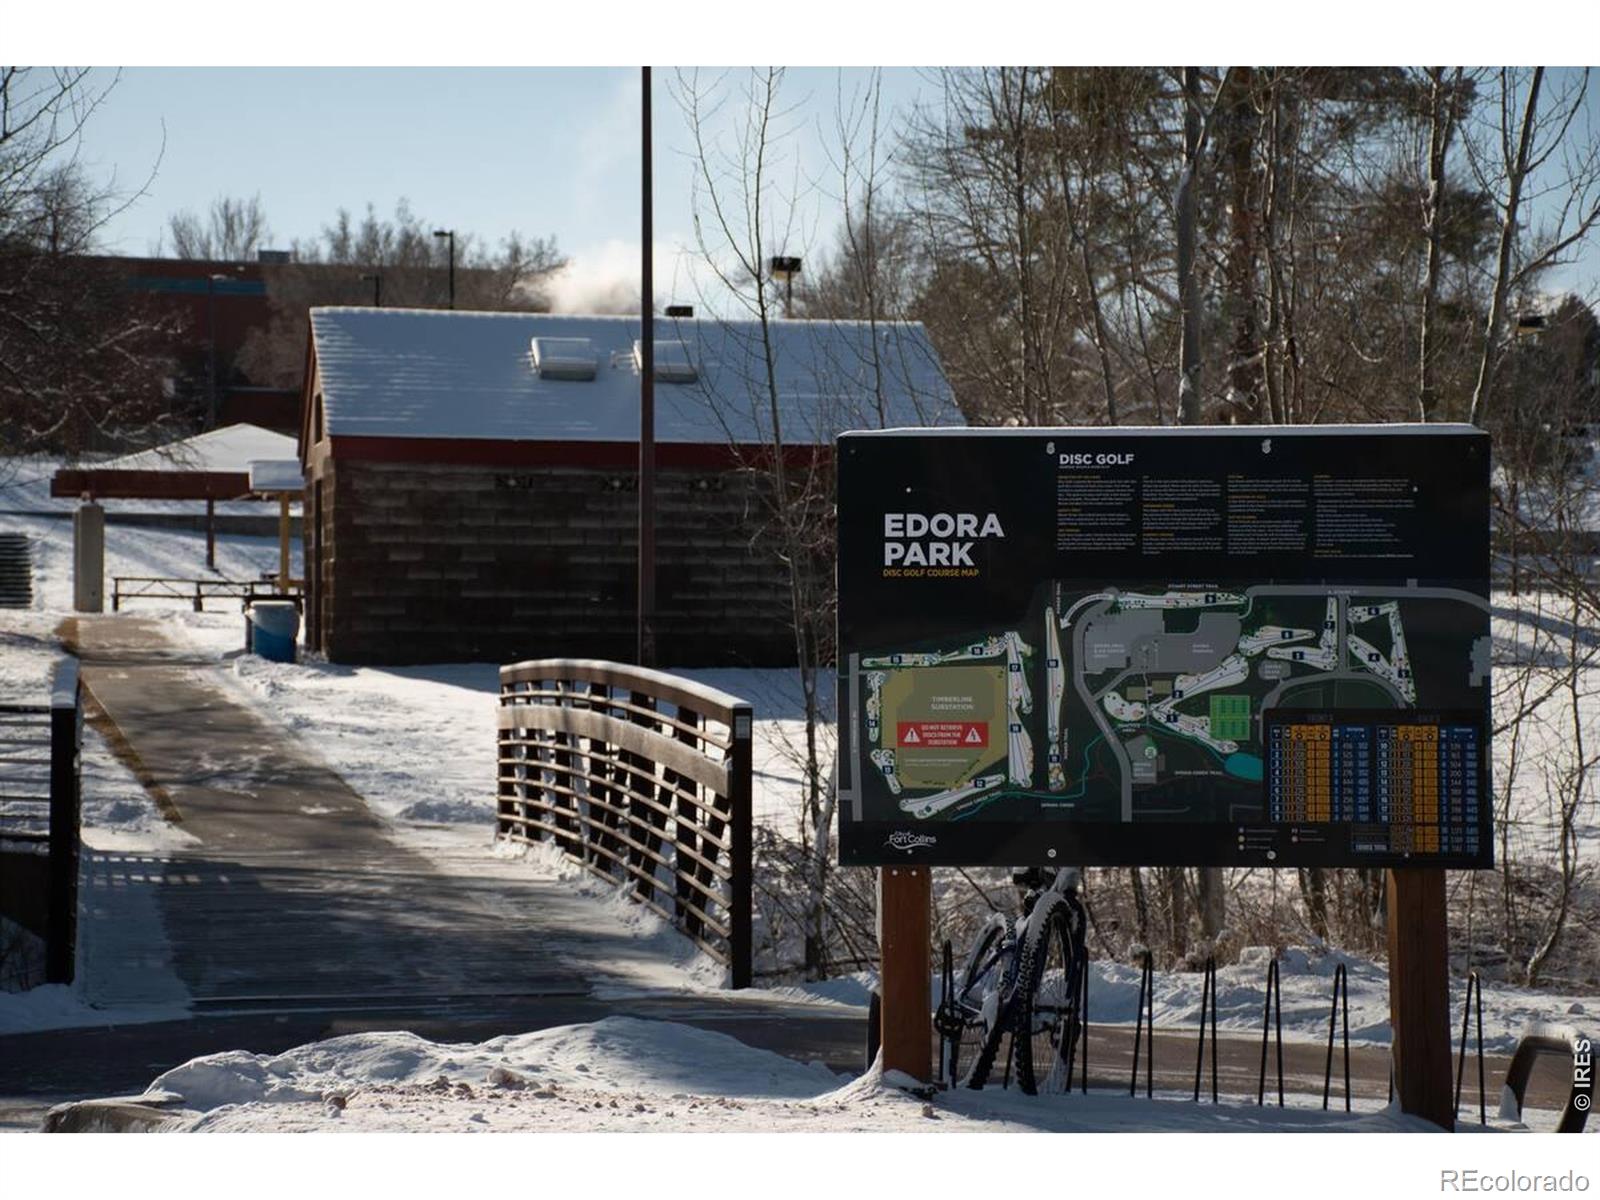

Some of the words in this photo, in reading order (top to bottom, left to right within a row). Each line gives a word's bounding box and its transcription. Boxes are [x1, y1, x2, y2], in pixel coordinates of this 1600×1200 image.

[1059, 454, 1092, 464] DISC
[1096, 454, 1134, 464] GOLF
[884, 513, 1005, 538] EDORA
[884, 542, 975, 566] PARK
[883, 568, 902, 577] DISC
[904, 568, 925, 577] GOLF
[927, 568, 960, 577] COURSE
[961, 568, 980, 577] MAP
[889, 834, 906, 844] Fort
[908, 834, 936, 844] Collins
